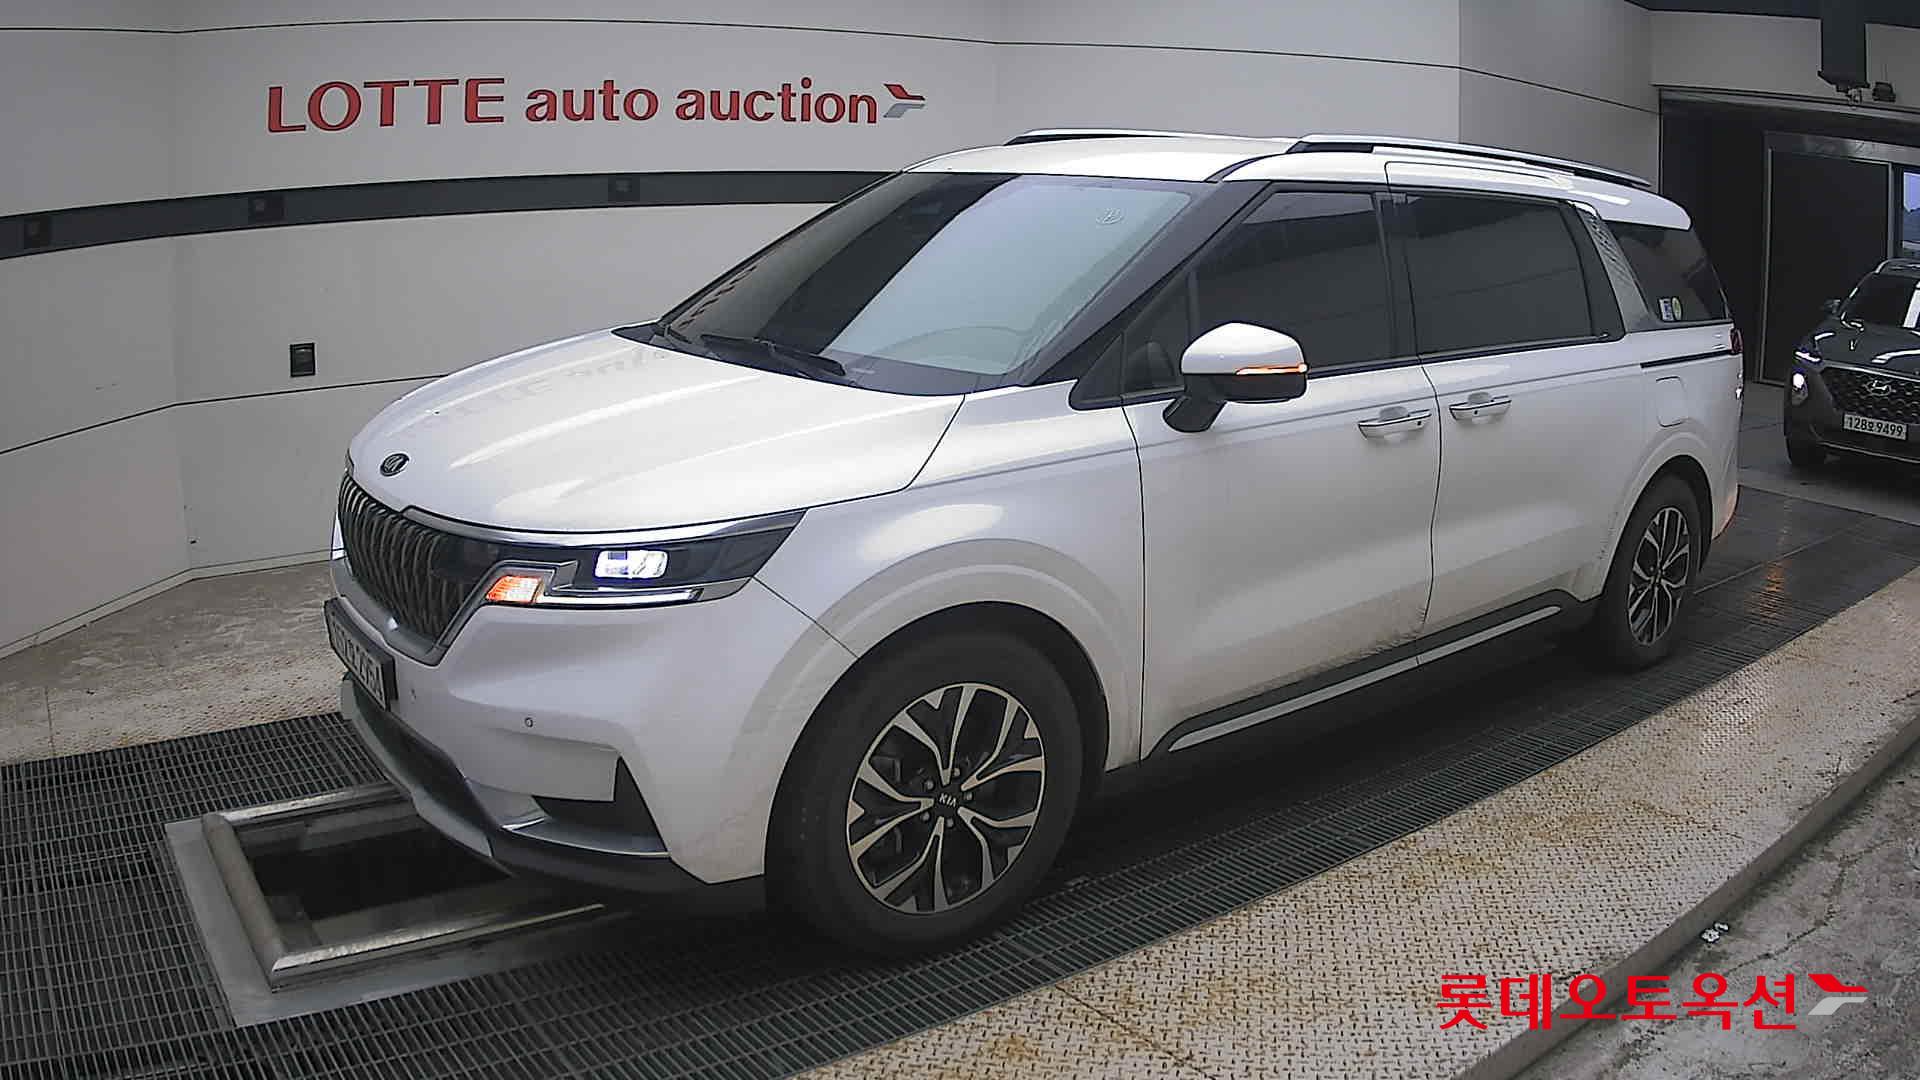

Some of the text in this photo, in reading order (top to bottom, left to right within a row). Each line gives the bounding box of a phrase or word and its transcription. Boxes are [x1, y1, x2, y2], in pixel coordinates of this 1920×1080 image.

[267, 77, 878, 133] LOTTE auto auction
[939, 792, 957, 807] KIA
